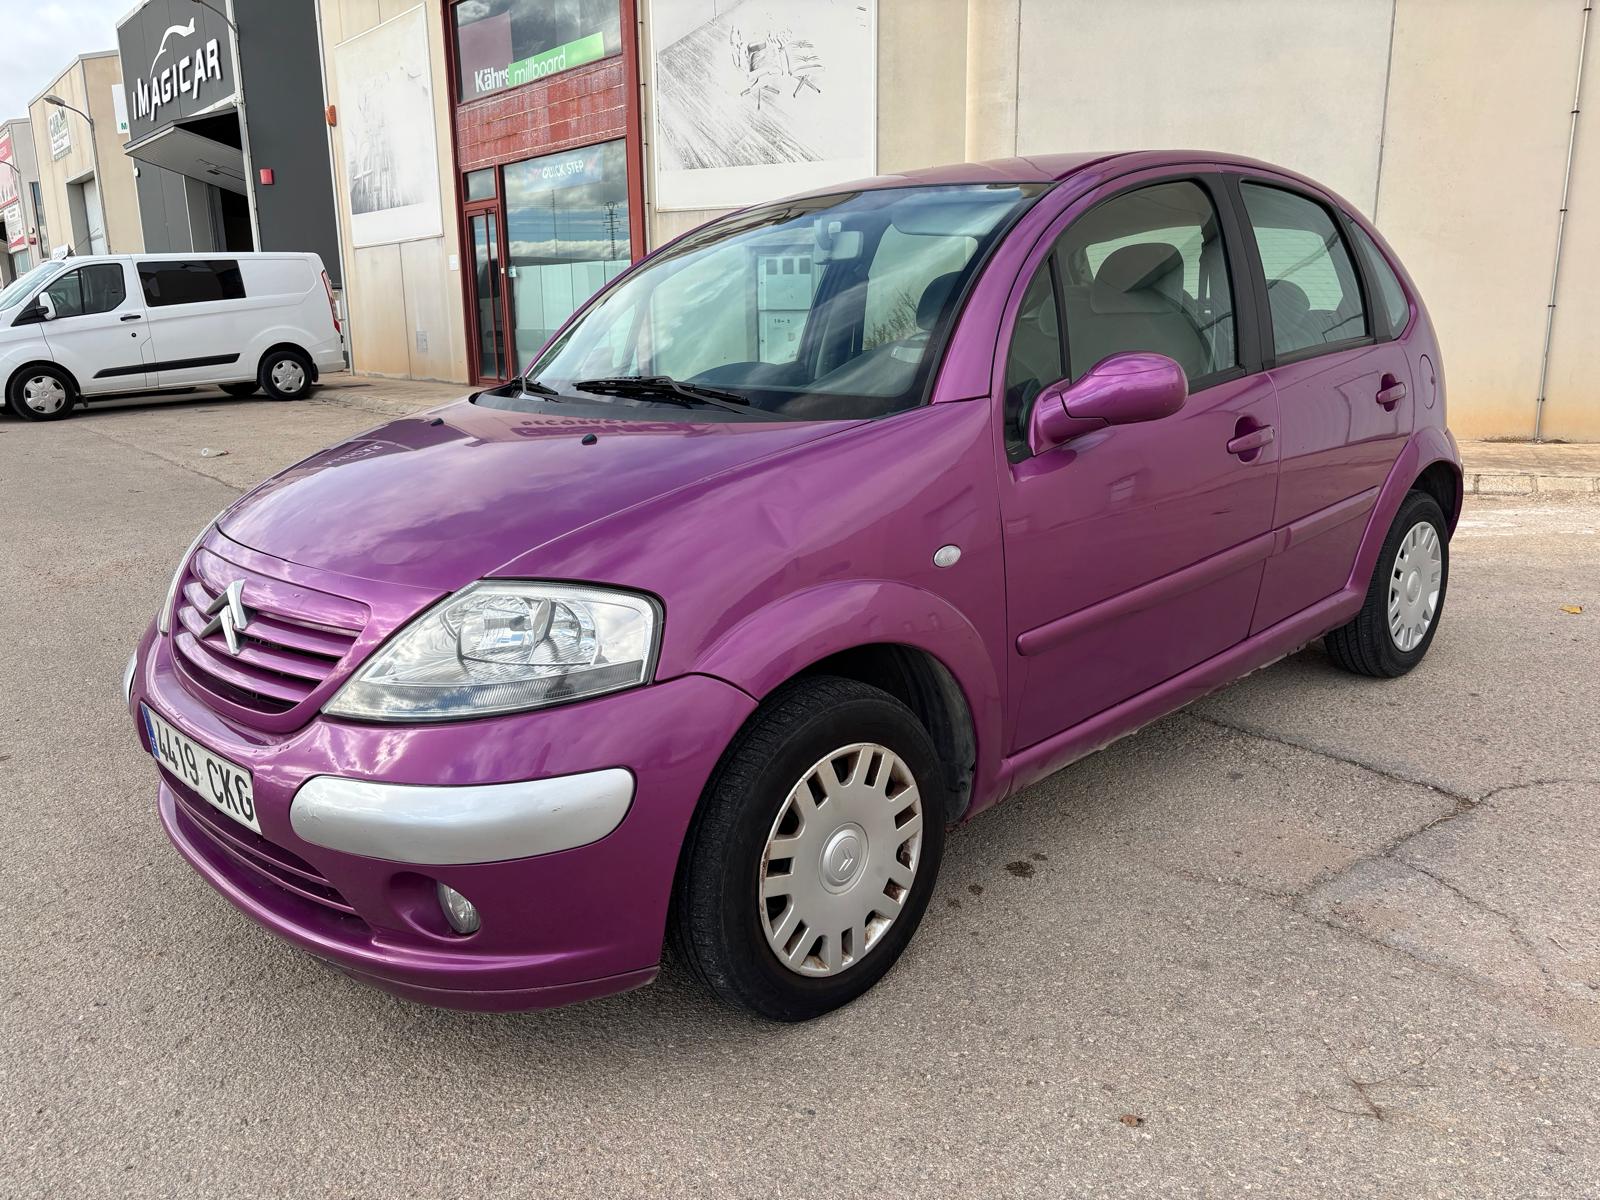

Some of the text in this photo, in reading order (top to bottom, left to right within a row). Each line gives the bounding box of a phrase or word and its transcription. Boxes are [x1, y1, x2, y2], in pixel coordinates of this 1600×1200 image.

[132, 38, 221, 121] IMAGICAR
[514, 46, 566, 85] millboard
[156, 720, 254, 822] 4419 CKG
